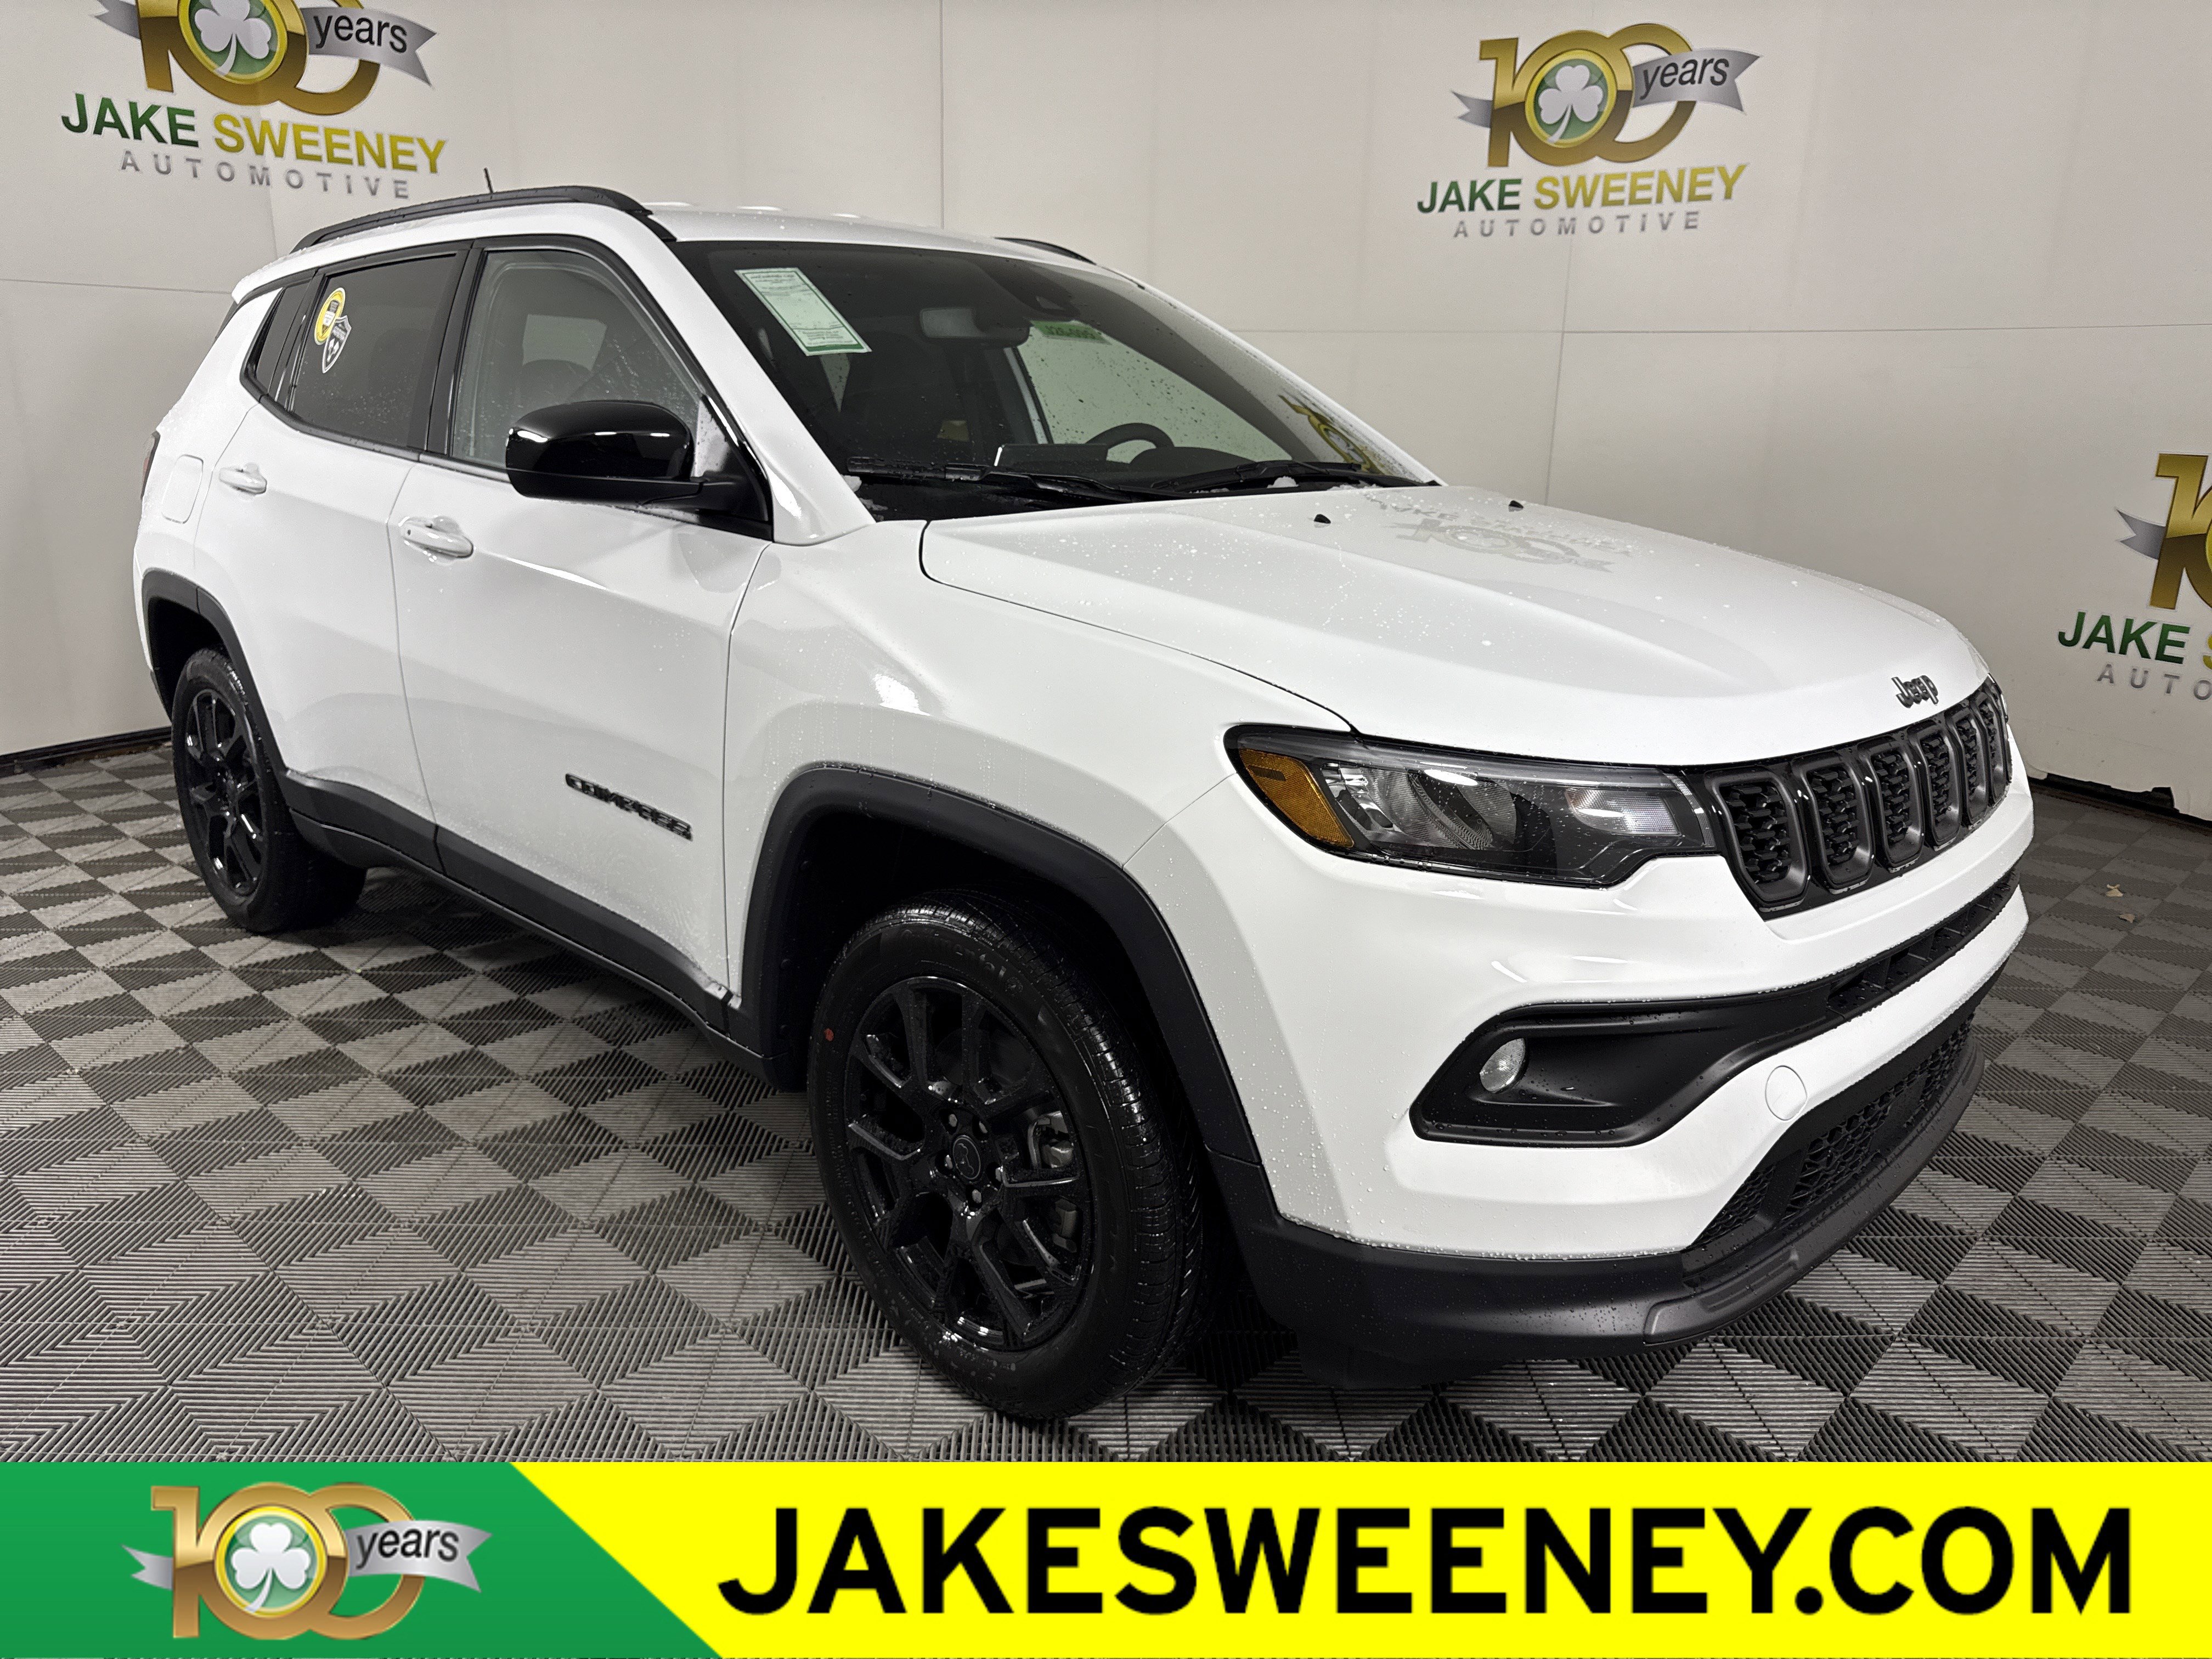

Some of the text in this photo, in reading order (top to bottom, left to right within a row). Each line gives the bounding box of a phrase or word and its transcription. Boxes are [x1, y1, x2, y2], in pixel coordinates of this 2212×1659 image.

[313, 13, 408, 53] years
[1480, 23, 1696, 167] 100
[1641, 58, 1730, 100] years
[61, 93, 447, 174] JAKE SWEENEY
[121, 151, 408, 199] AUTOMOTIVE
[1417, 165, 1748, 213] JAKE SWEENEY
[1453, 211, 1700, 238] AUTOMOTIVE
[2058, 612, 2190, 664] JAKE
[1891, 675, 1939, 708] Jeep
[565, 774, 693, 842] COMPASS
